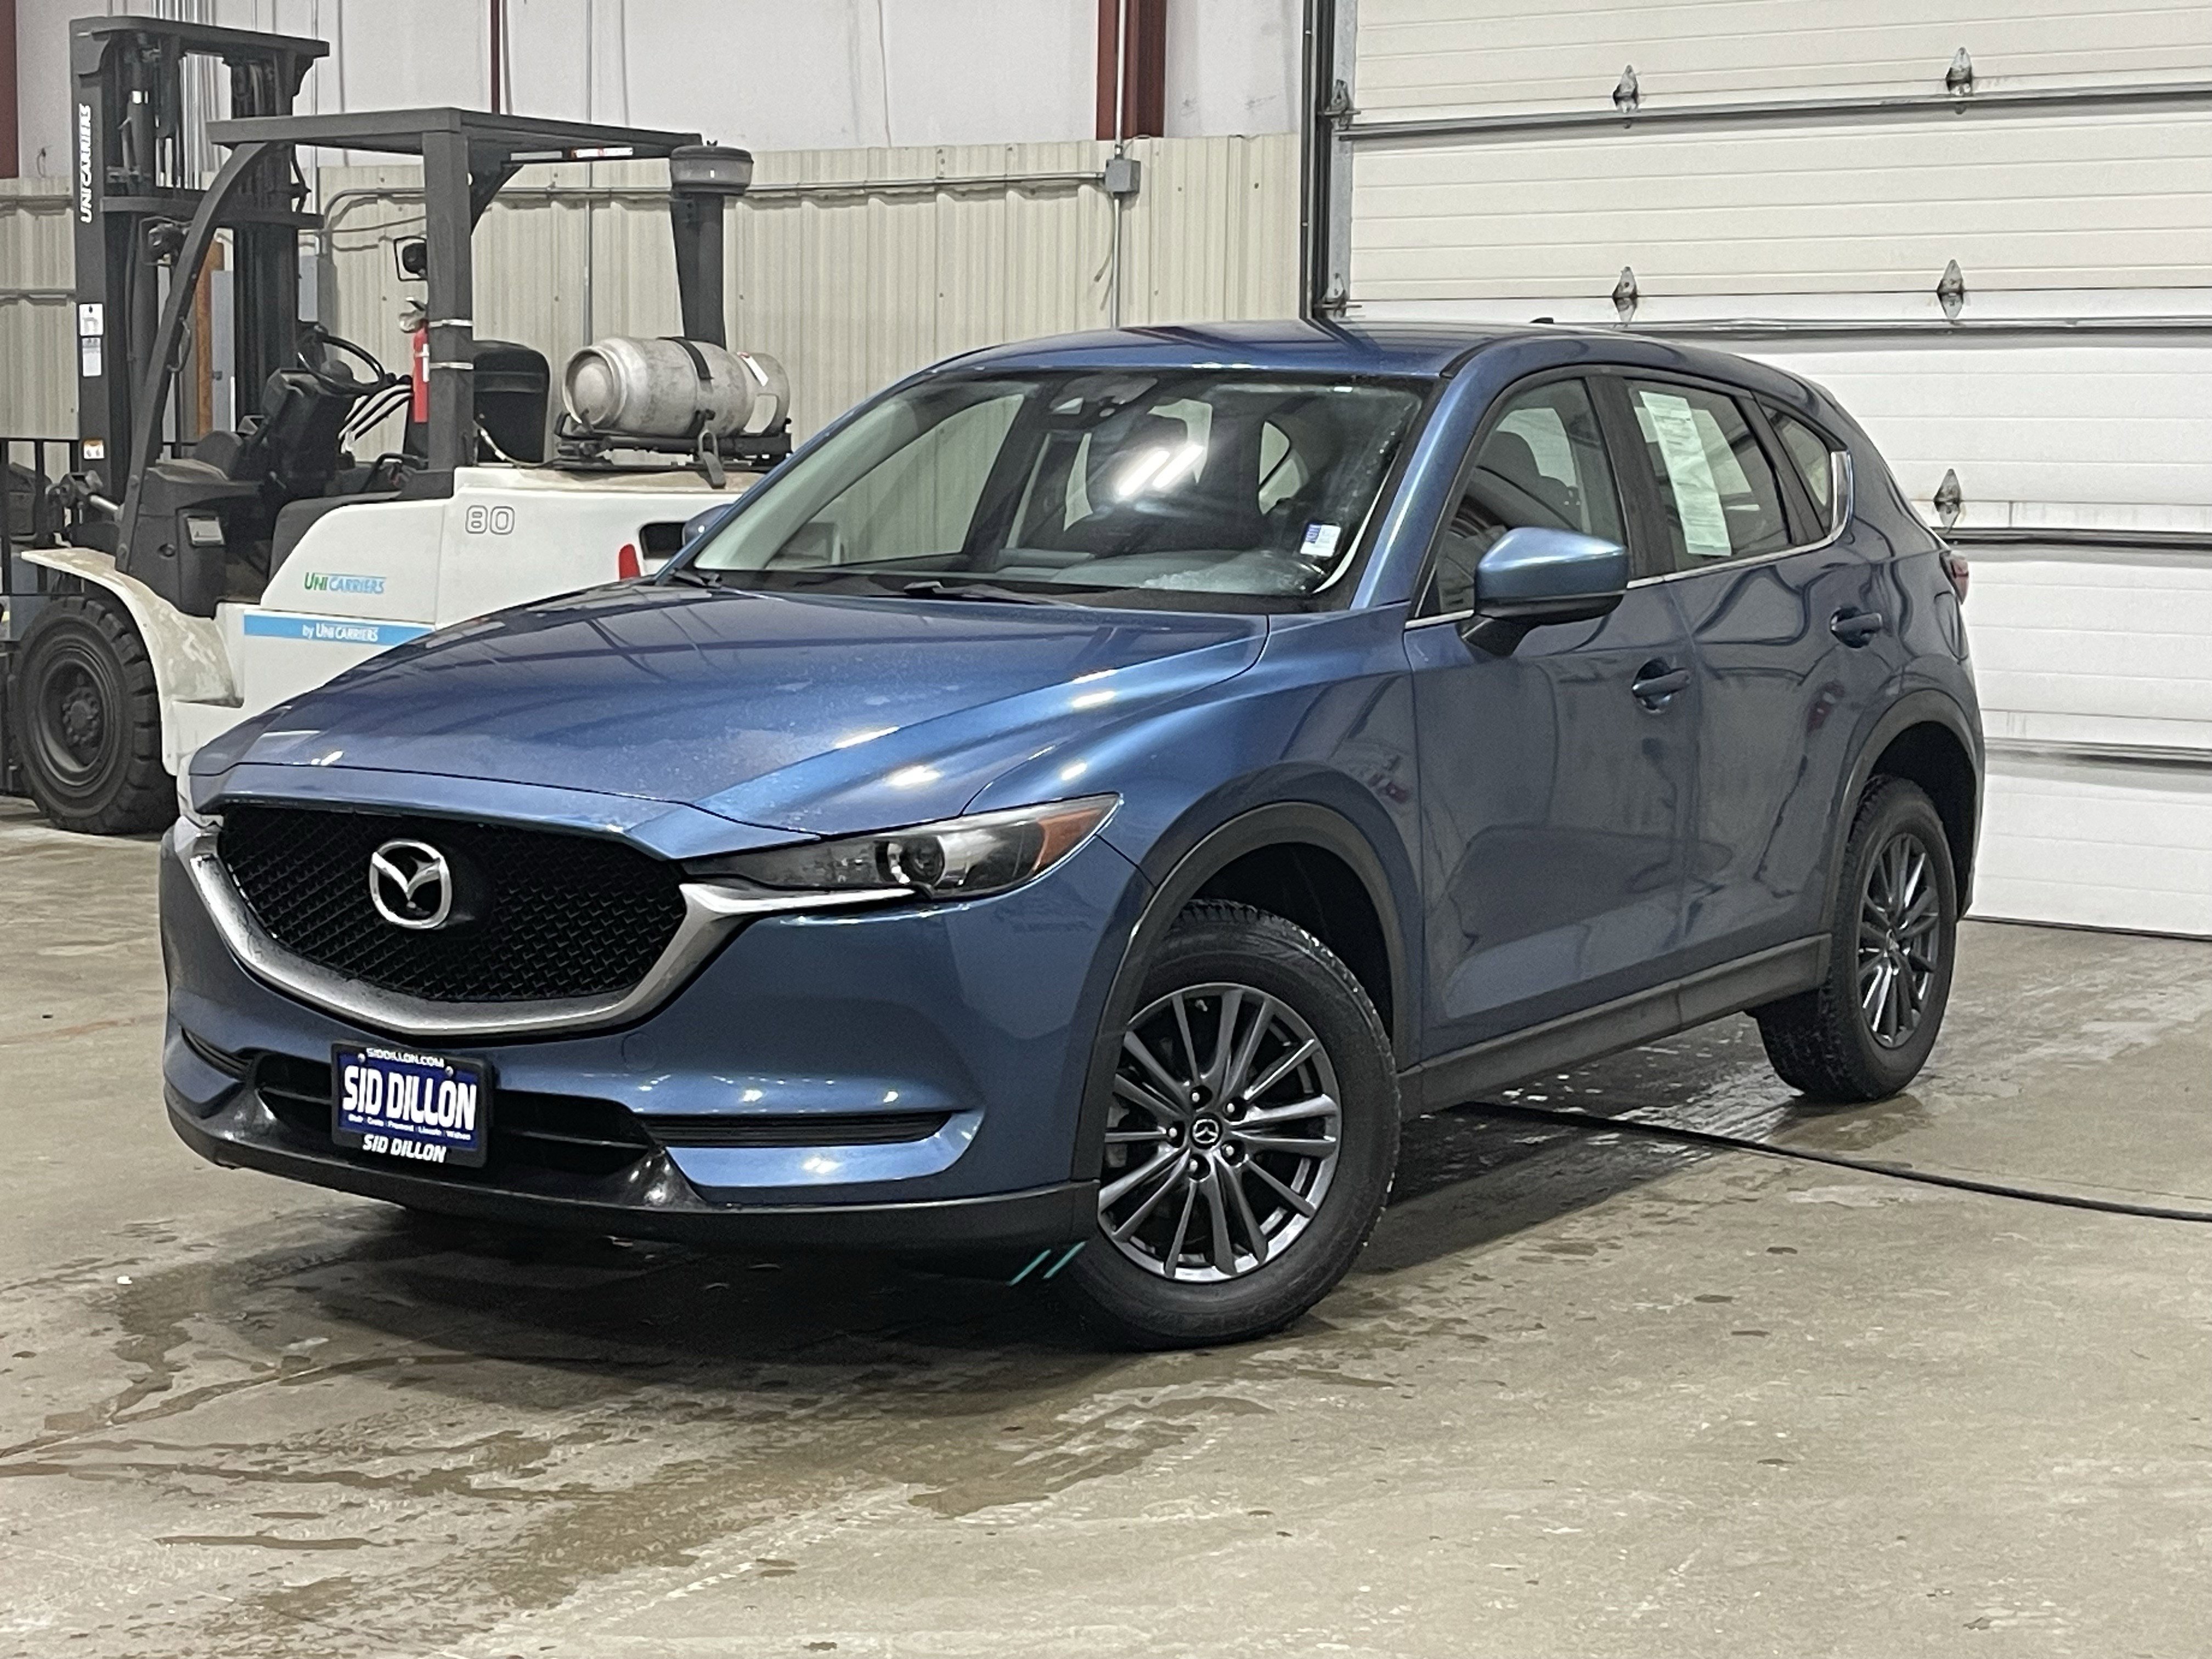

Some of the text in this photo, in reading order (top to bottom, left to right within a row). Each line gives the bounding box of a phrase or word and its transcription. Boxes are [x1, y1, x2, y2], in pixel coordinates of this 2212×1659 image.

[465, 505, 515, 535] 80
[303, 624, 314, 640] by
[366, 1048, 444, 1068] SIDDILLON.COM
[342, 1065, 383, 1115] SID
[386, 1072, 477, 1131] DILLON
[363, 1134, 447, 1163] SID DILLON
